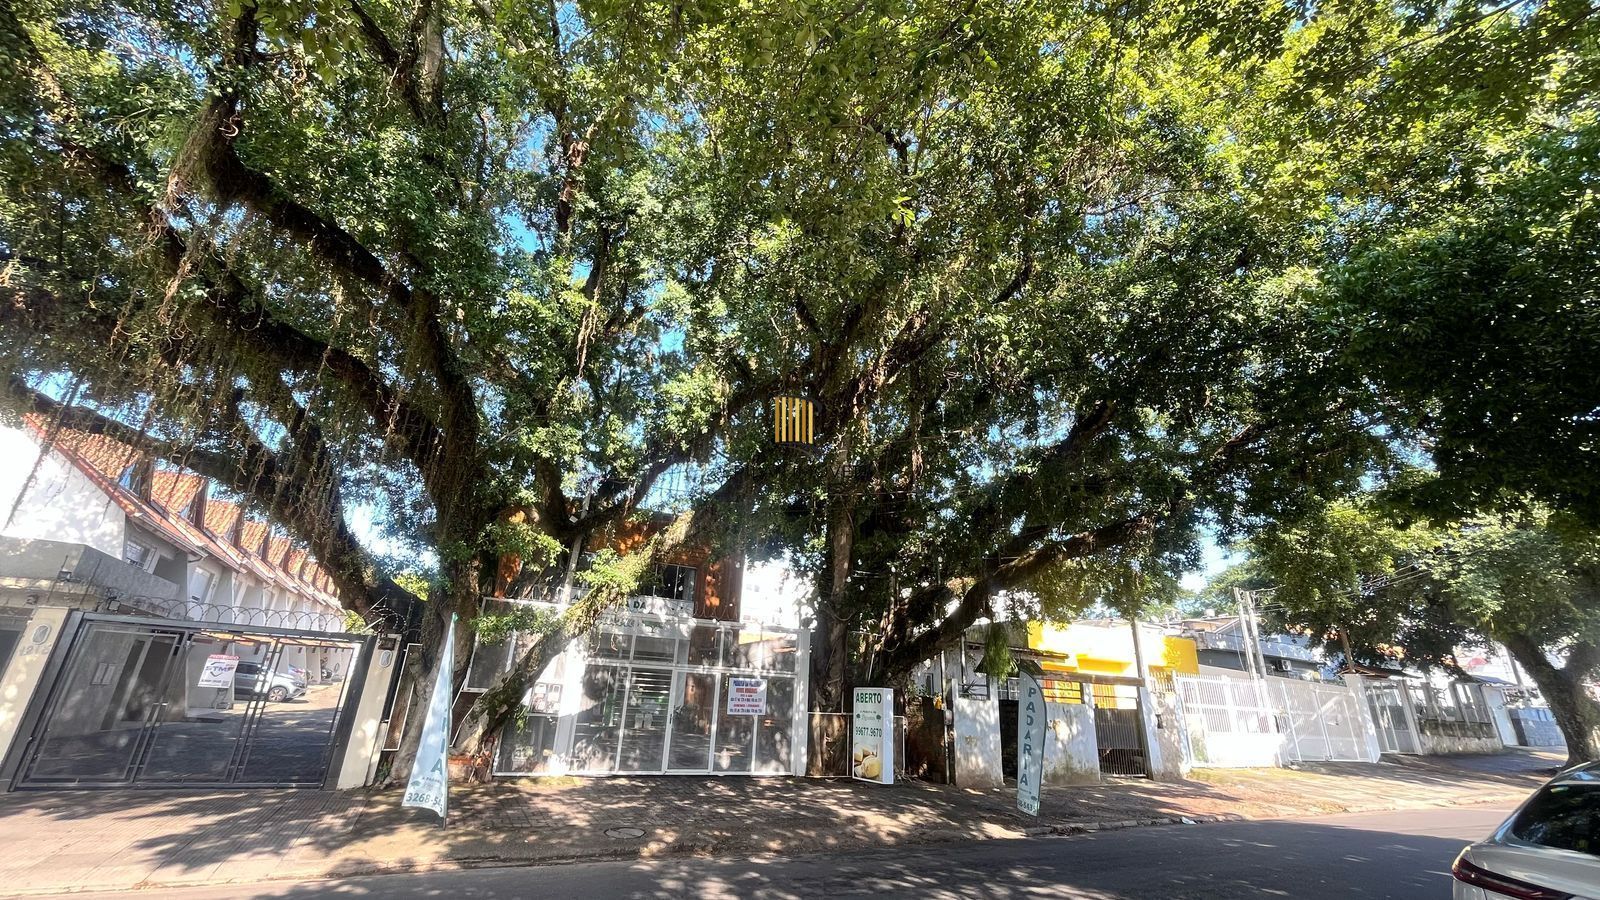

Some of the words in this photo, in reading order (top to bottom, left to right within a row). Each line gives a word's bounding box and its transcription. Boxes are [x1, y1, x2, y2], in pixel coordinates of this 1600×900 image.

[855, 692, 882, 704] ABERTO
[855, 726, 882, 738] 99677.9670
[1019, 686, 1036, 786] PADARIA
